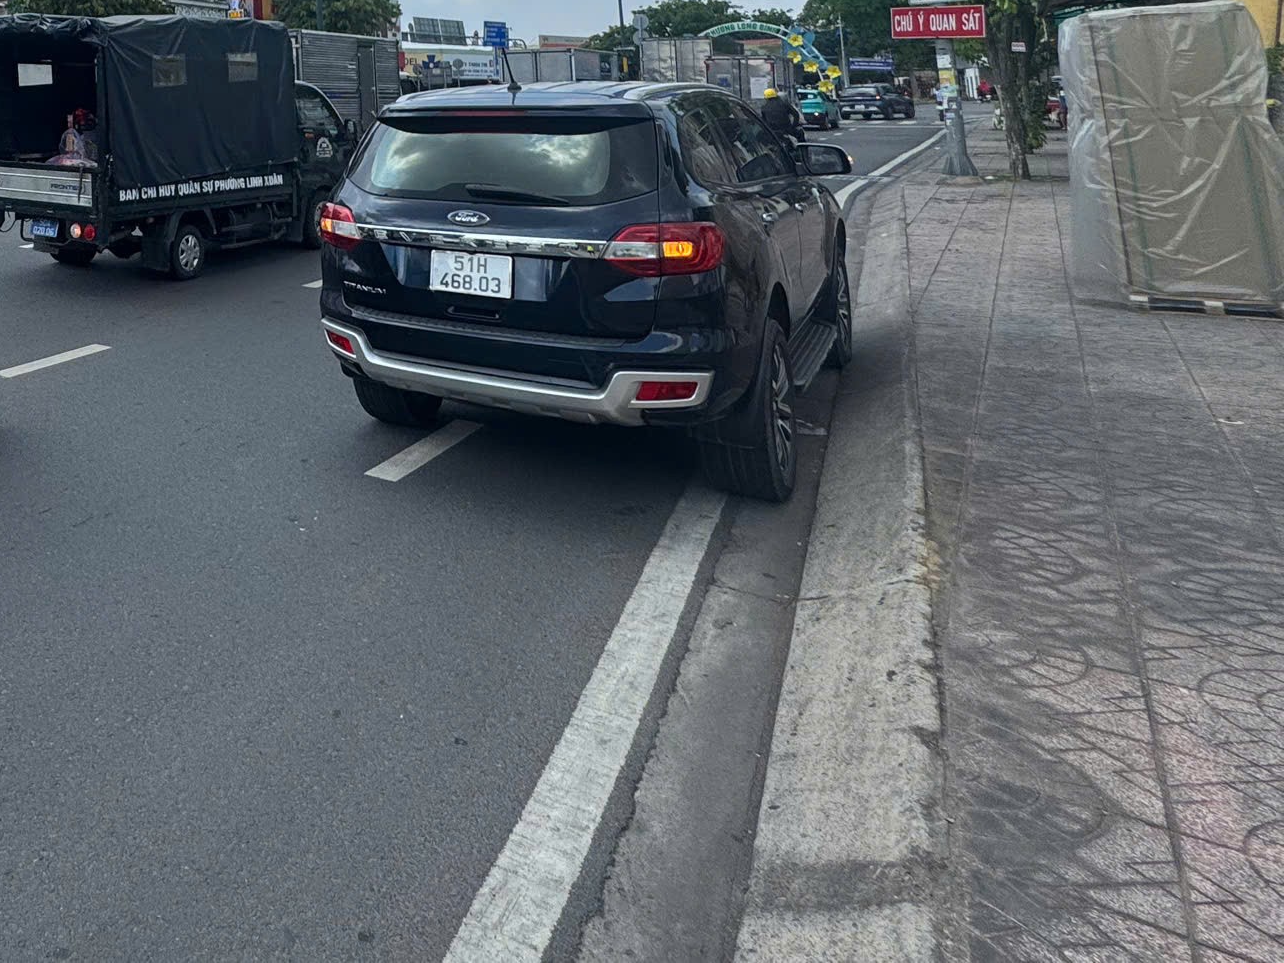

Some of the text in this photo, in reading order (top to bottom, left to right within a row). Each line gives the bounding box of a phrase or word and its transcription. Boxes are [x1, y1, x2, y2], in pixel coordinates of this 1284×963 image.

[894, 9, 980, 32] CHÚ Ý QUAN SÁT
[119, 189, 140, 202] BAN
[159, 184, 175, 197] HUY
[246, 176, 263, 188] LINH
[454, 212, 479, 224] Ford
[453, 256, 488, 275] 51H
[439, 273, 501, 294] 468.03
